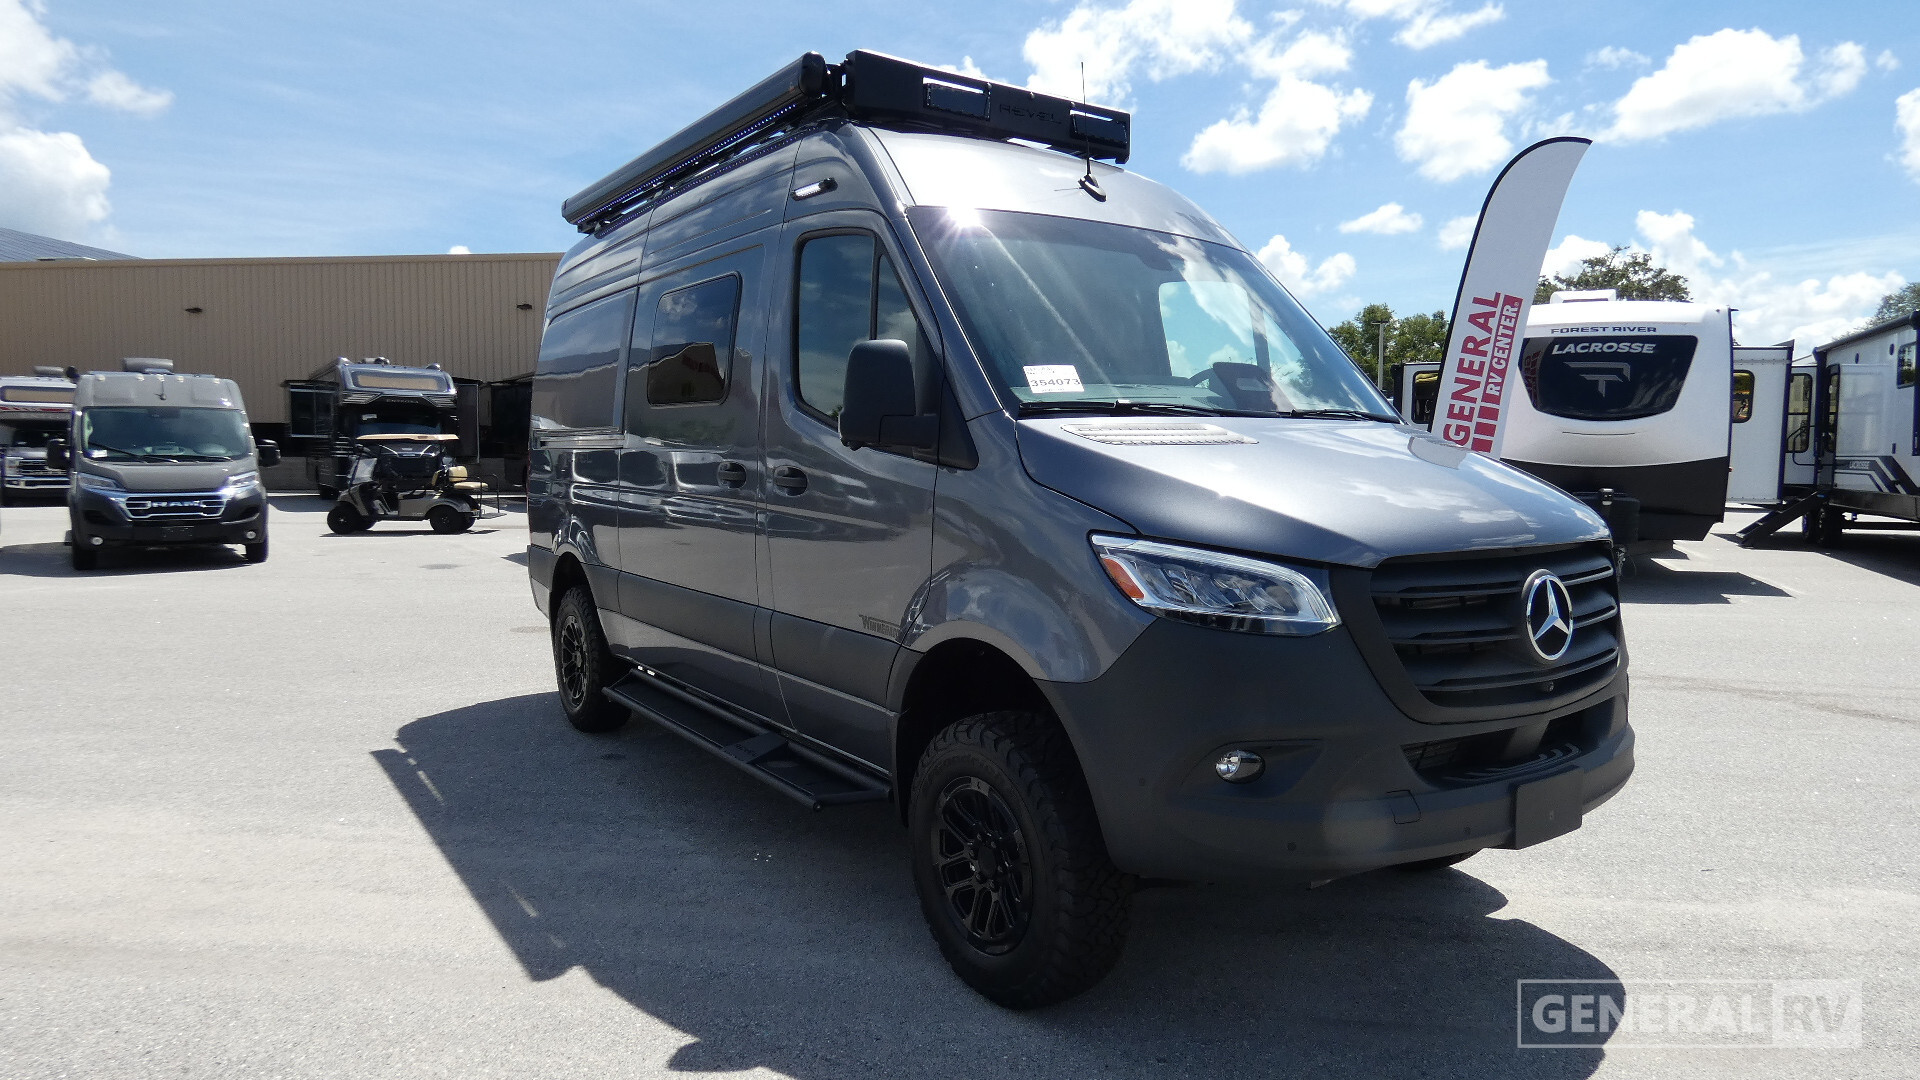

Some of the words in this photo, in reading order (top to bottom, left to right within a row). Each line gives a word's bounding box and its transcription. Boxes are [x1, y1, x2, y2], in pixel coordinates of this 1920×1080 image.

[1000, 104, 1062, 124] REVEL
[1550, 326, 1610, 334] FOREST
[1551, 342, 1657, 355] LACROSSE
[1443, 292, 1501, 447] GENERAL
[1030, 378, 1081, 387] 354073
[1486, 373, 1502, 396] RV
